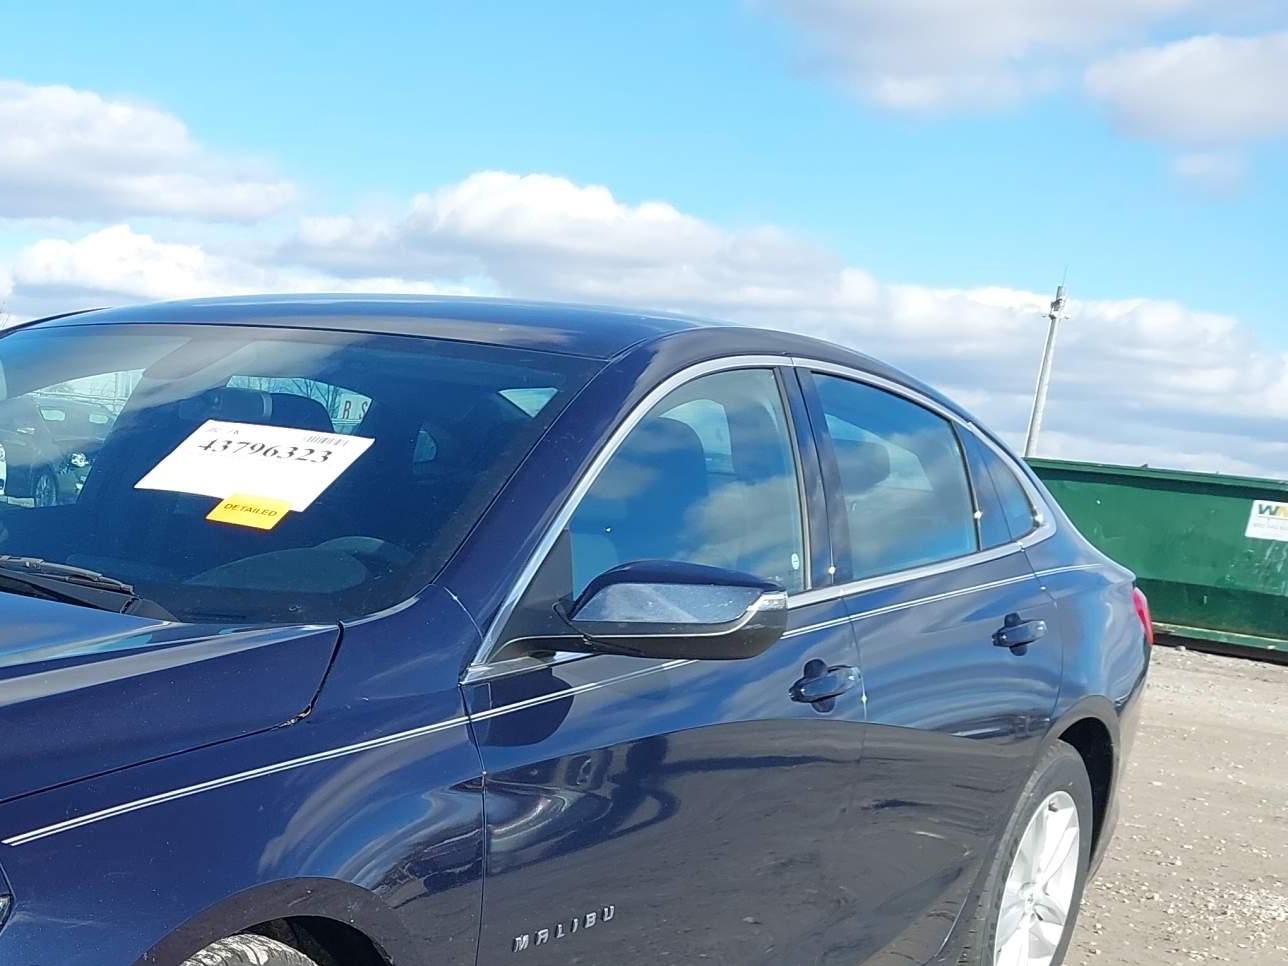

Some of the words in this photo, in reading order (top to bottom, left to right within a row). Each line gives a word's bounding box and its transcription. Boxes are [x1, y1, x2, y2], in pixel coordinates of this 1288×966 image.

[197, 438, 334, 464] 43796323
[223, 503, 278, 518] DETAILED
[512, 904, 616, 954] MALIBU
